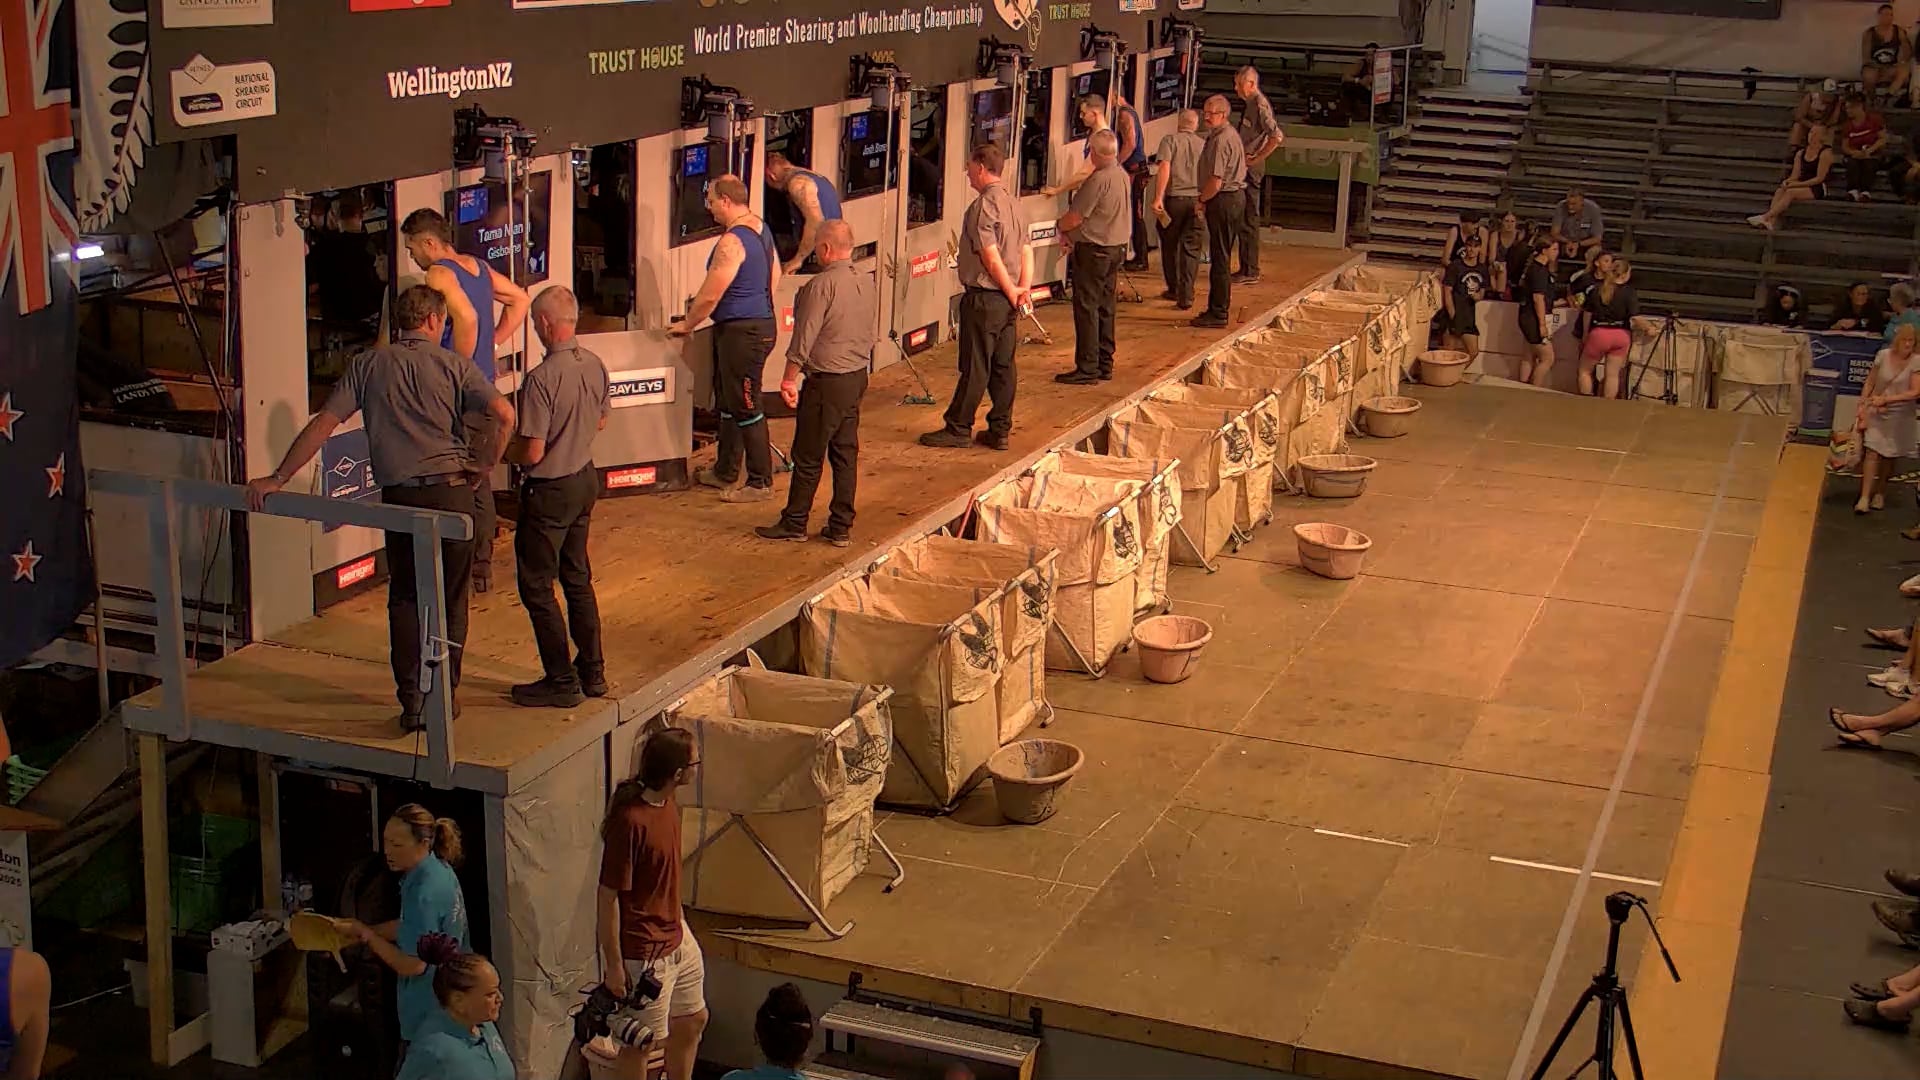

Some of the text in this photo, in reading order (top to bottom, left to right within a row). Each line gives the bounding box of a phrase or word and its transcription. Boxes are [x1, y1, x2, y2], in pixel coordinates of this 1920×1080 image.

[1048, 2, 1091, 20] TRUST HOUSE
[694, 3, 984, 54] World Premier Shearing and Woolhandling Championship
[588, 44, 685, 75] TRUST HOUSE
[234, 72, 270, 85] NATIONAL
[387, 62, 513, 99] WellingtonNZ
[235, 84, 270, 97] SHEARING
[235, 97, 263, 109] CIRCUIT
[478, 228, 503, 243] Tama
[681, 224, 688, 237] 2
[487, 243, 522, 260] Gisbone
[608, 380, 663, 396] BAYLEYS
[608, 471, 655, 486] Heiniger
[339, 562, 375, 584] Heiniger
